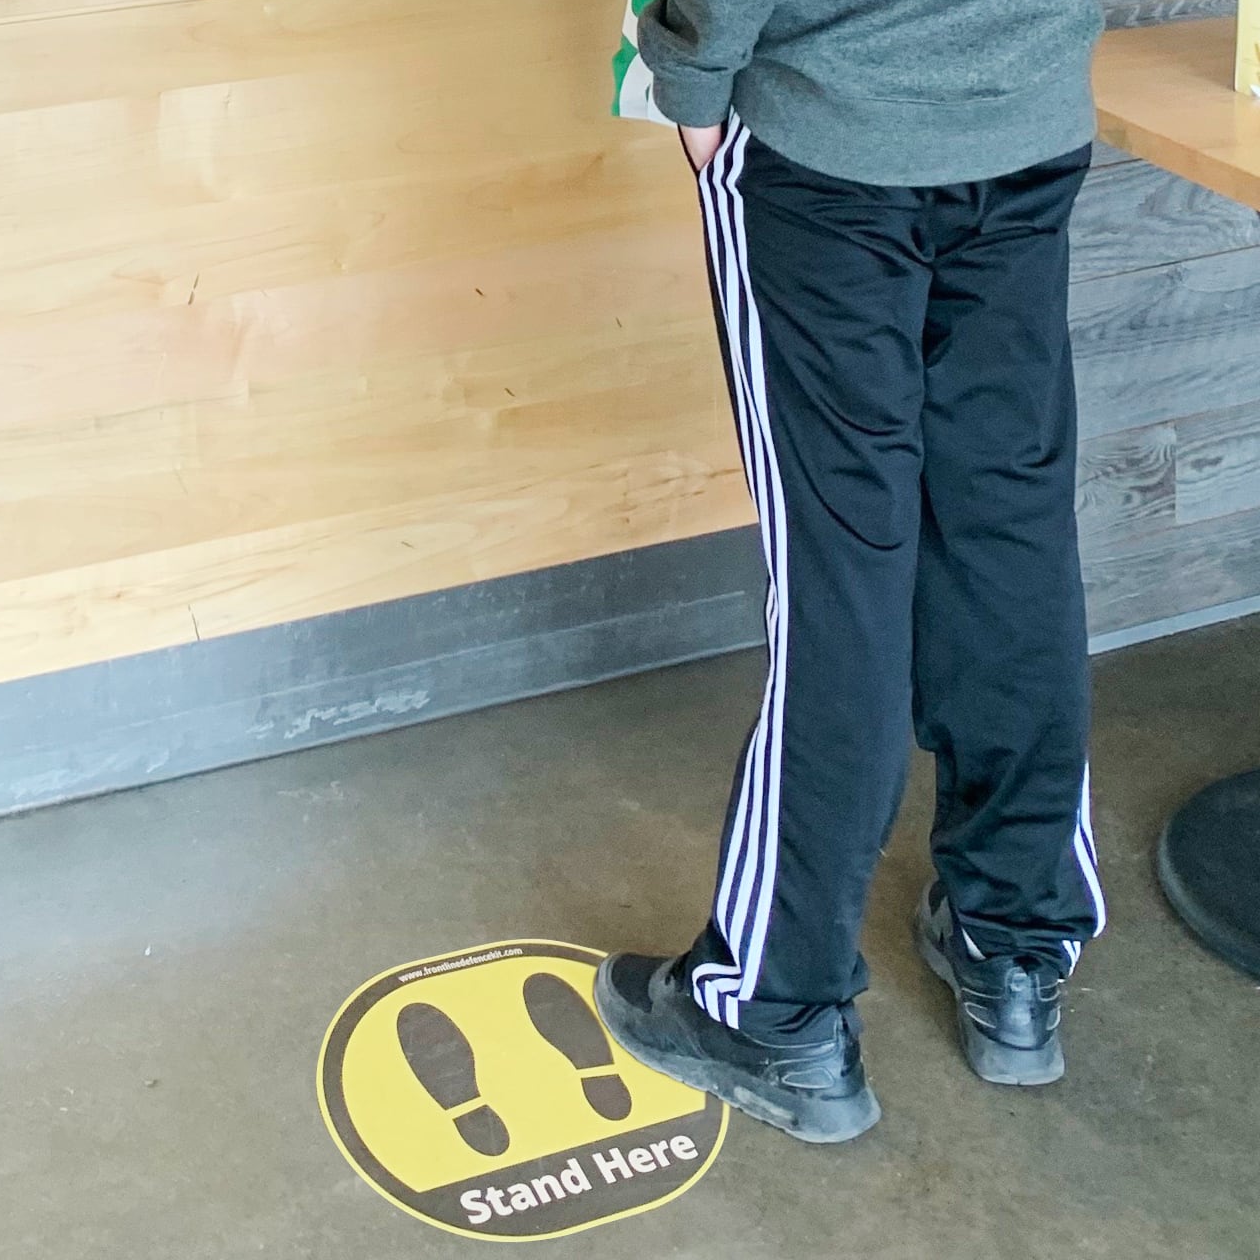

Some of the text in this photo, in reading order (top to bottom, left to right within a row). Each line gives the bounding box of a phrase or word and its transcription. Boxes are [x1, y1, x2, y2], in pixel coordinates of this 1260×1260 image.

[398, 947, 523, 983] www.frontlinedefencekit.com
[459, 1135, 700, 1225] Stand Here
